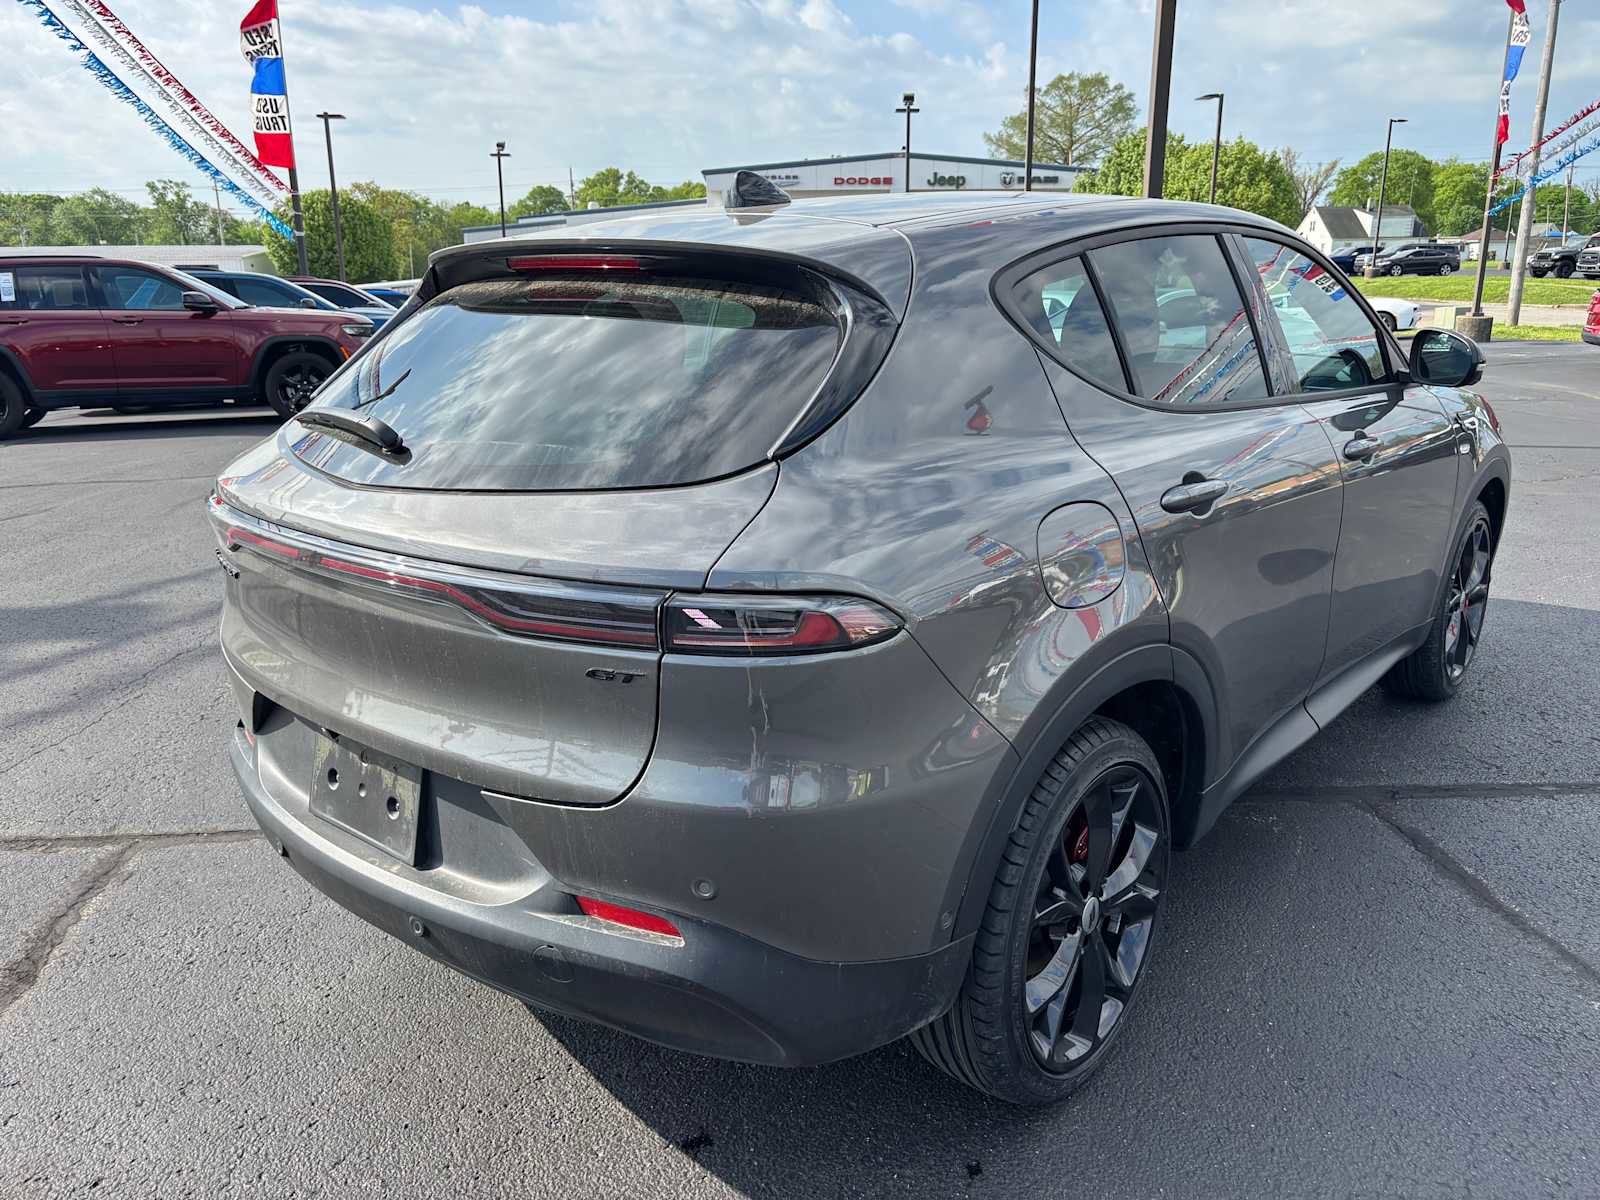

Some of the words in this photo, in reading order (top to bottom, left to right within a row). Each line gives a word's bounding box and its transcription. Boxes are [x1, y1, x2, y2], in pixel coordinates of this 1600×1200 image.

[834, 177, 893, 185] DODGE
[927, 171, 967, 190] Jeep
[584, 666, 646, 684] GT
